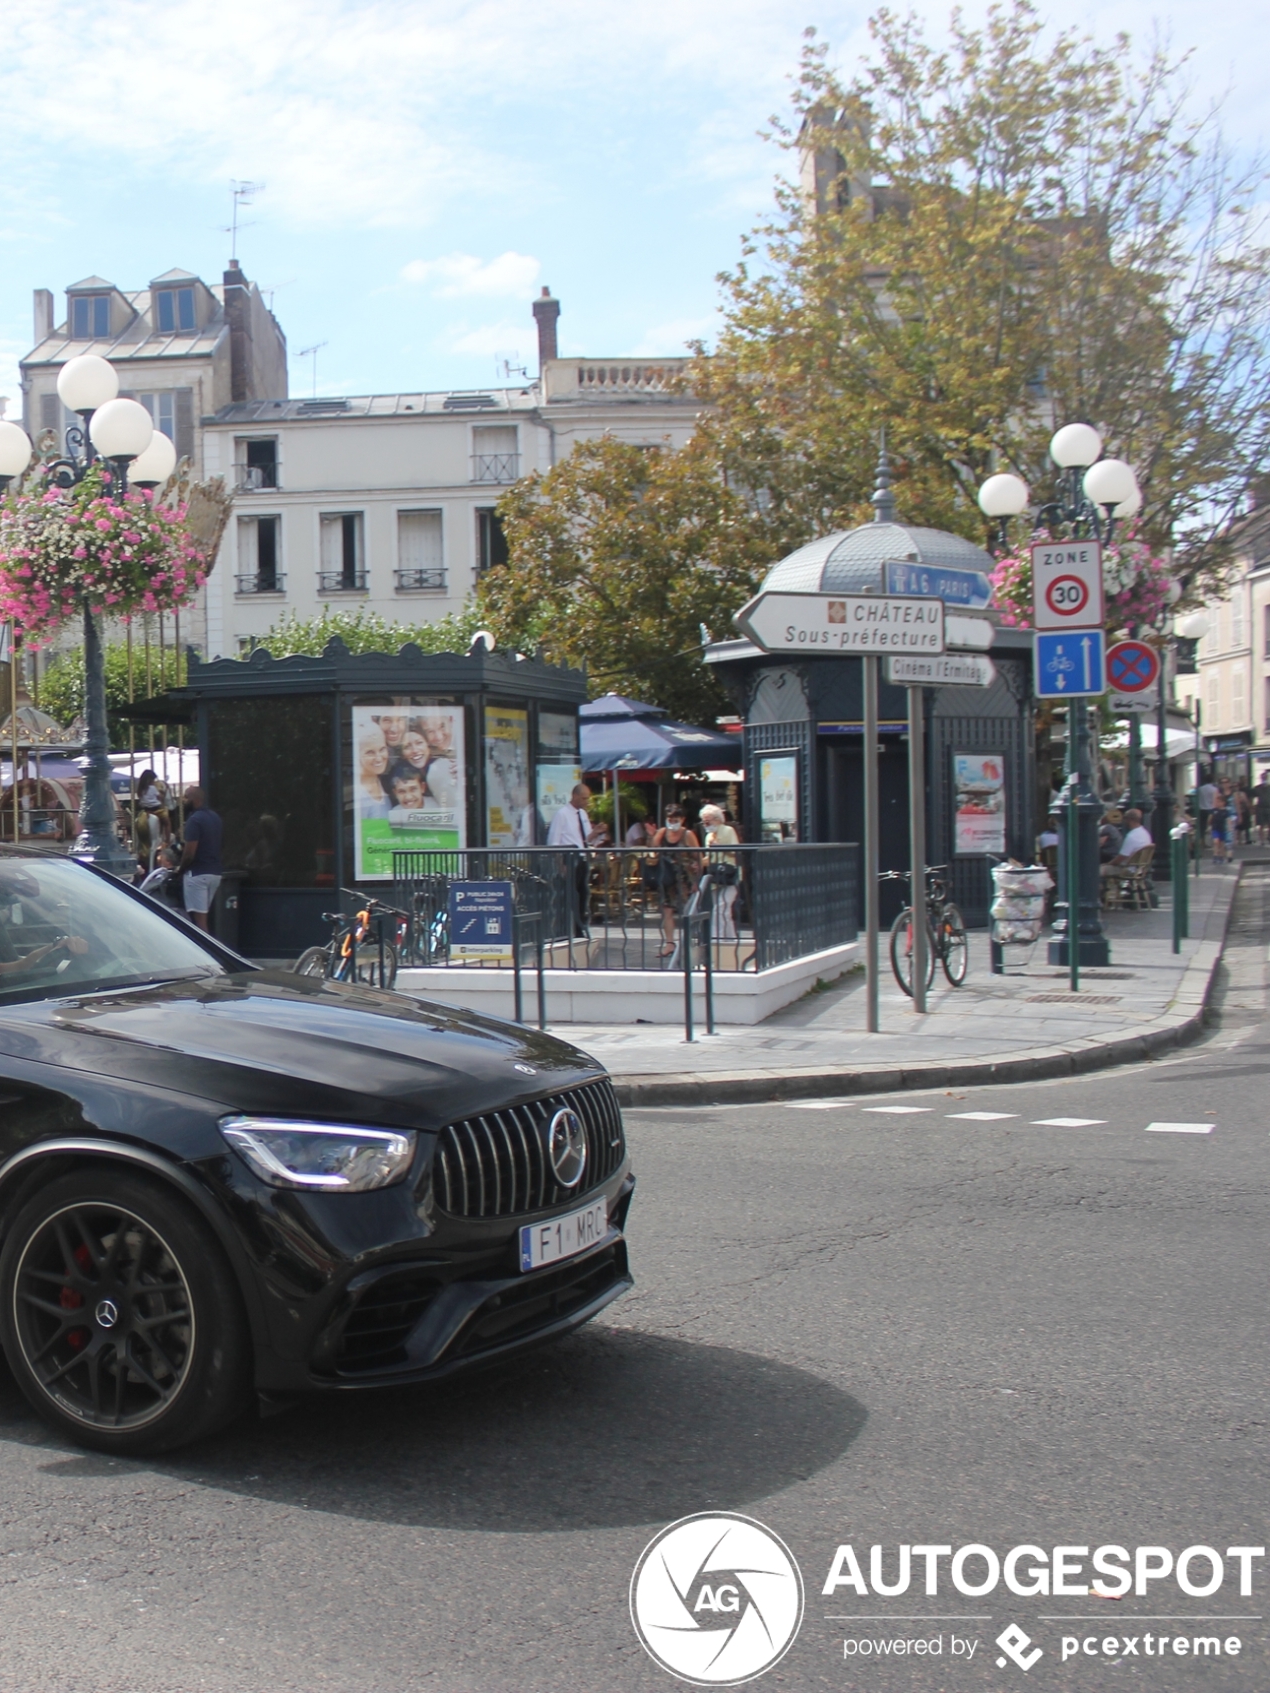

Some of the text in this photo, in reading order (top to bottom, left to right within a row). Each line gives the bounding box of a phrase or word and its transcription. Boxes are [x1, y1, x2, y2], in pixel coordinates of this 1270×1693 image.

[1043, 550, 1089, 566] ZONE
[1054, 585, 1080, 604] 30
[854, 602, 940, 624] CHÂTEAU
[784, 625, 938, 648] Sous-préfecture
[892, 659, 988, 683] Cinéma l'Ermitage
[407, 813, 455, 822] Fluocaril
[456, 892, 465, 903] P
